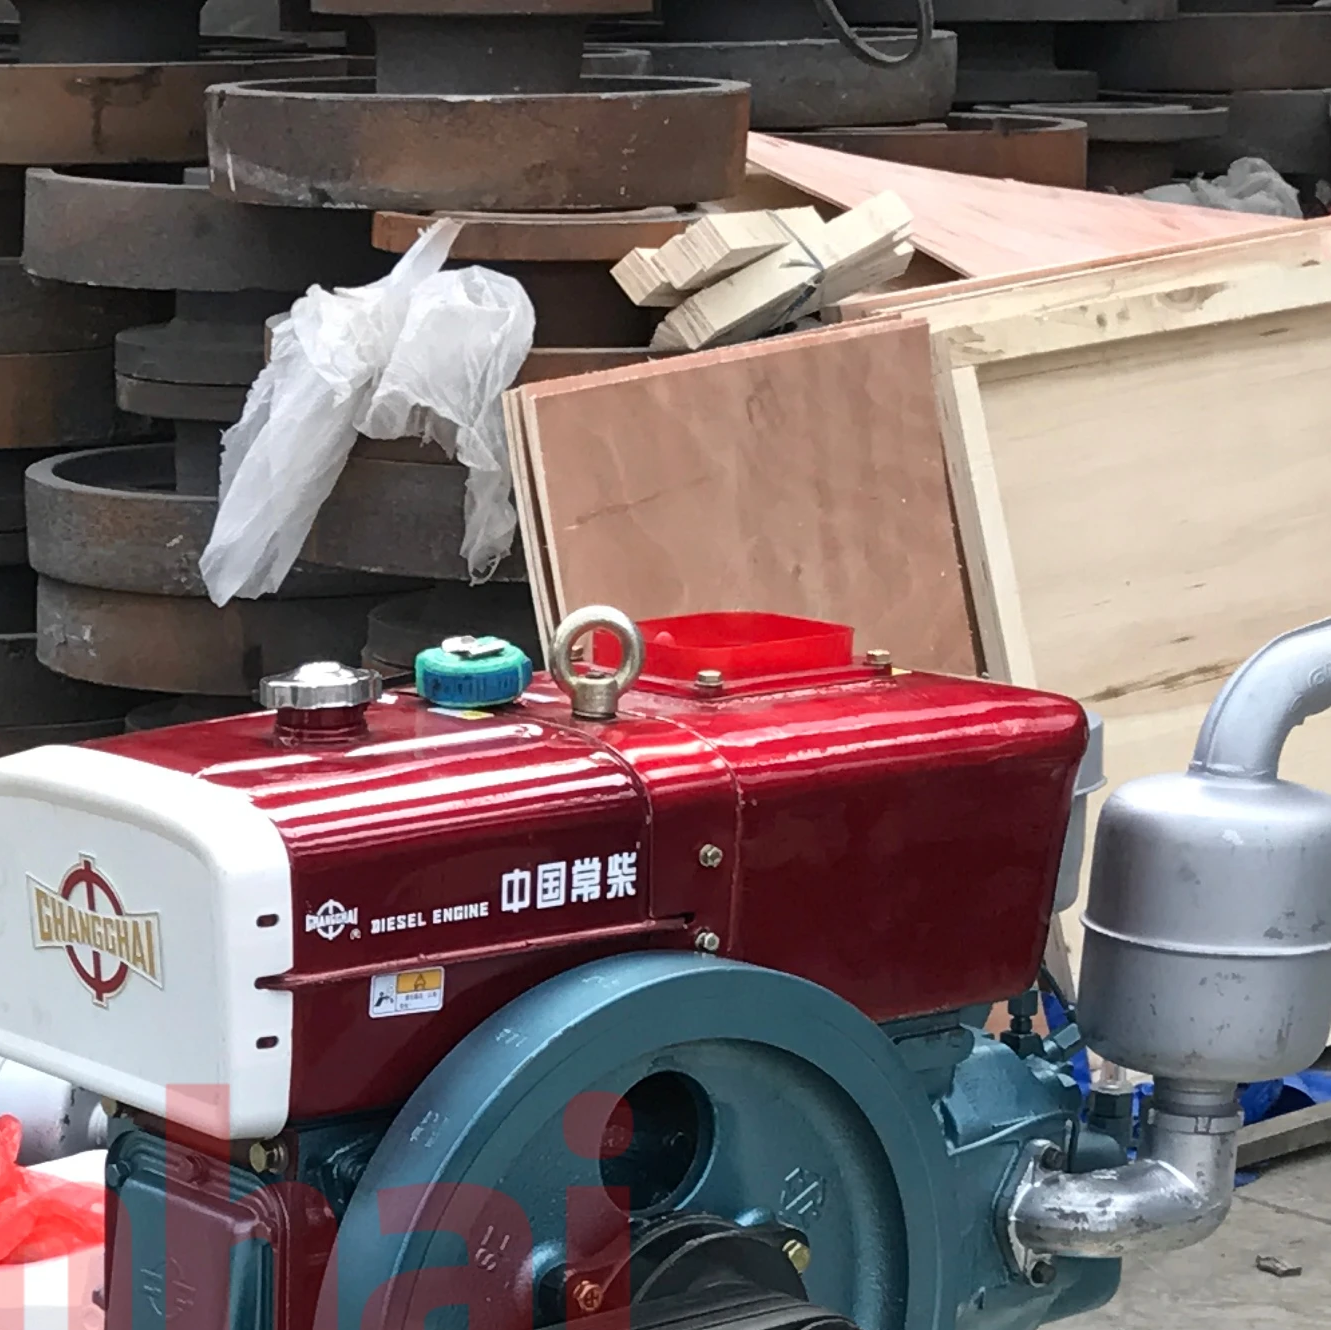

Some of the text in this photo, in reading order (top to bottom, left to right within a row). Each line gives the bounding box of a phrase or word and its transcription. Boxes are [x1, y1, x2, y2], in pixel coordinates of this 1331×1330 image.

[501, 851, 637, 913] 中国常柴
[371, 901, 489, 934] DIESEL ENGINE
